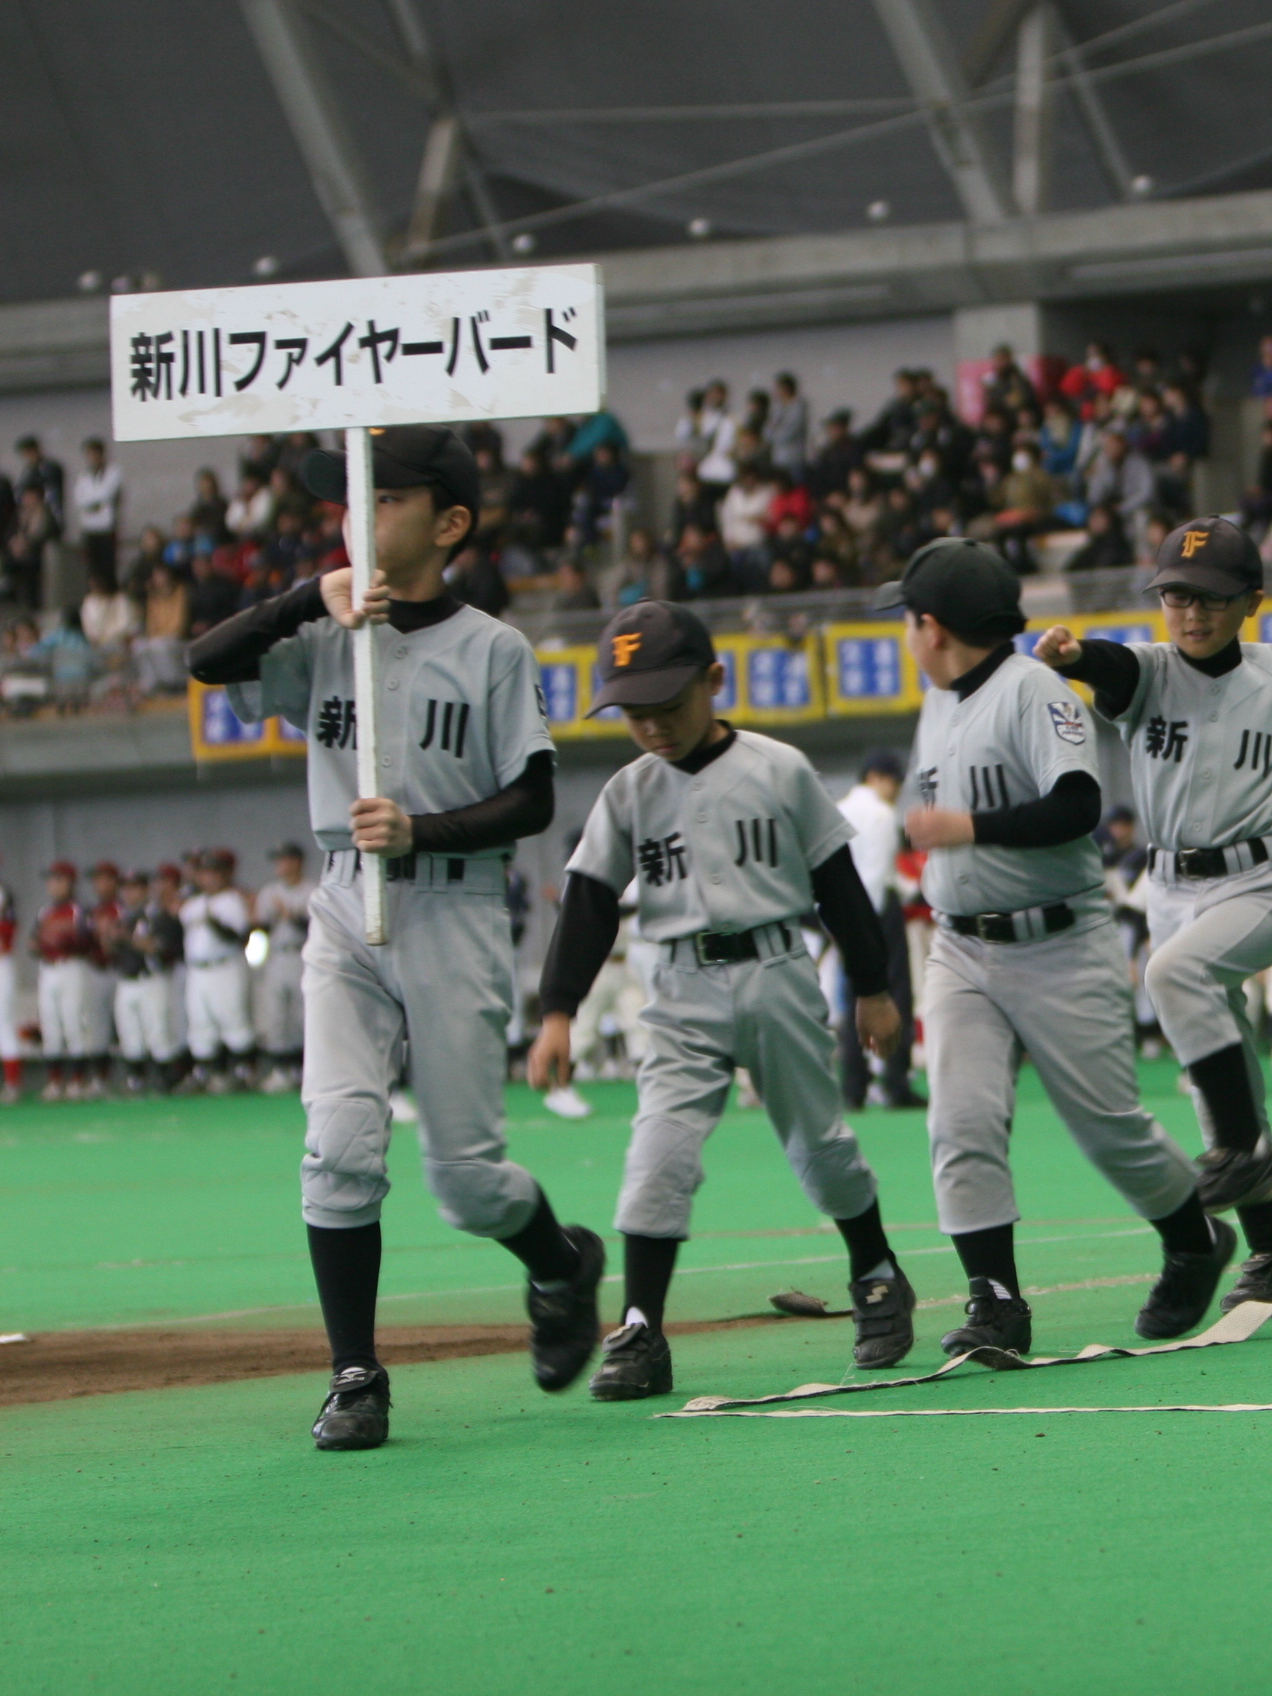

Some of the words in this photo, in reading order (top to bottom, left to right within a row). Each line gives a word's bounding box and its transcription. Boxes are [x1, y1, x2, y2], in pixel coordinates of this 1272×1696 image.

[129, 305, 578, 402] 新川ファイヤーバード
[1181, 530, 1210, 558] F
[611, 632, 642, 667] F
[1145, 714, 1188, 763] 新
[638, 832, 688, 887] 新
